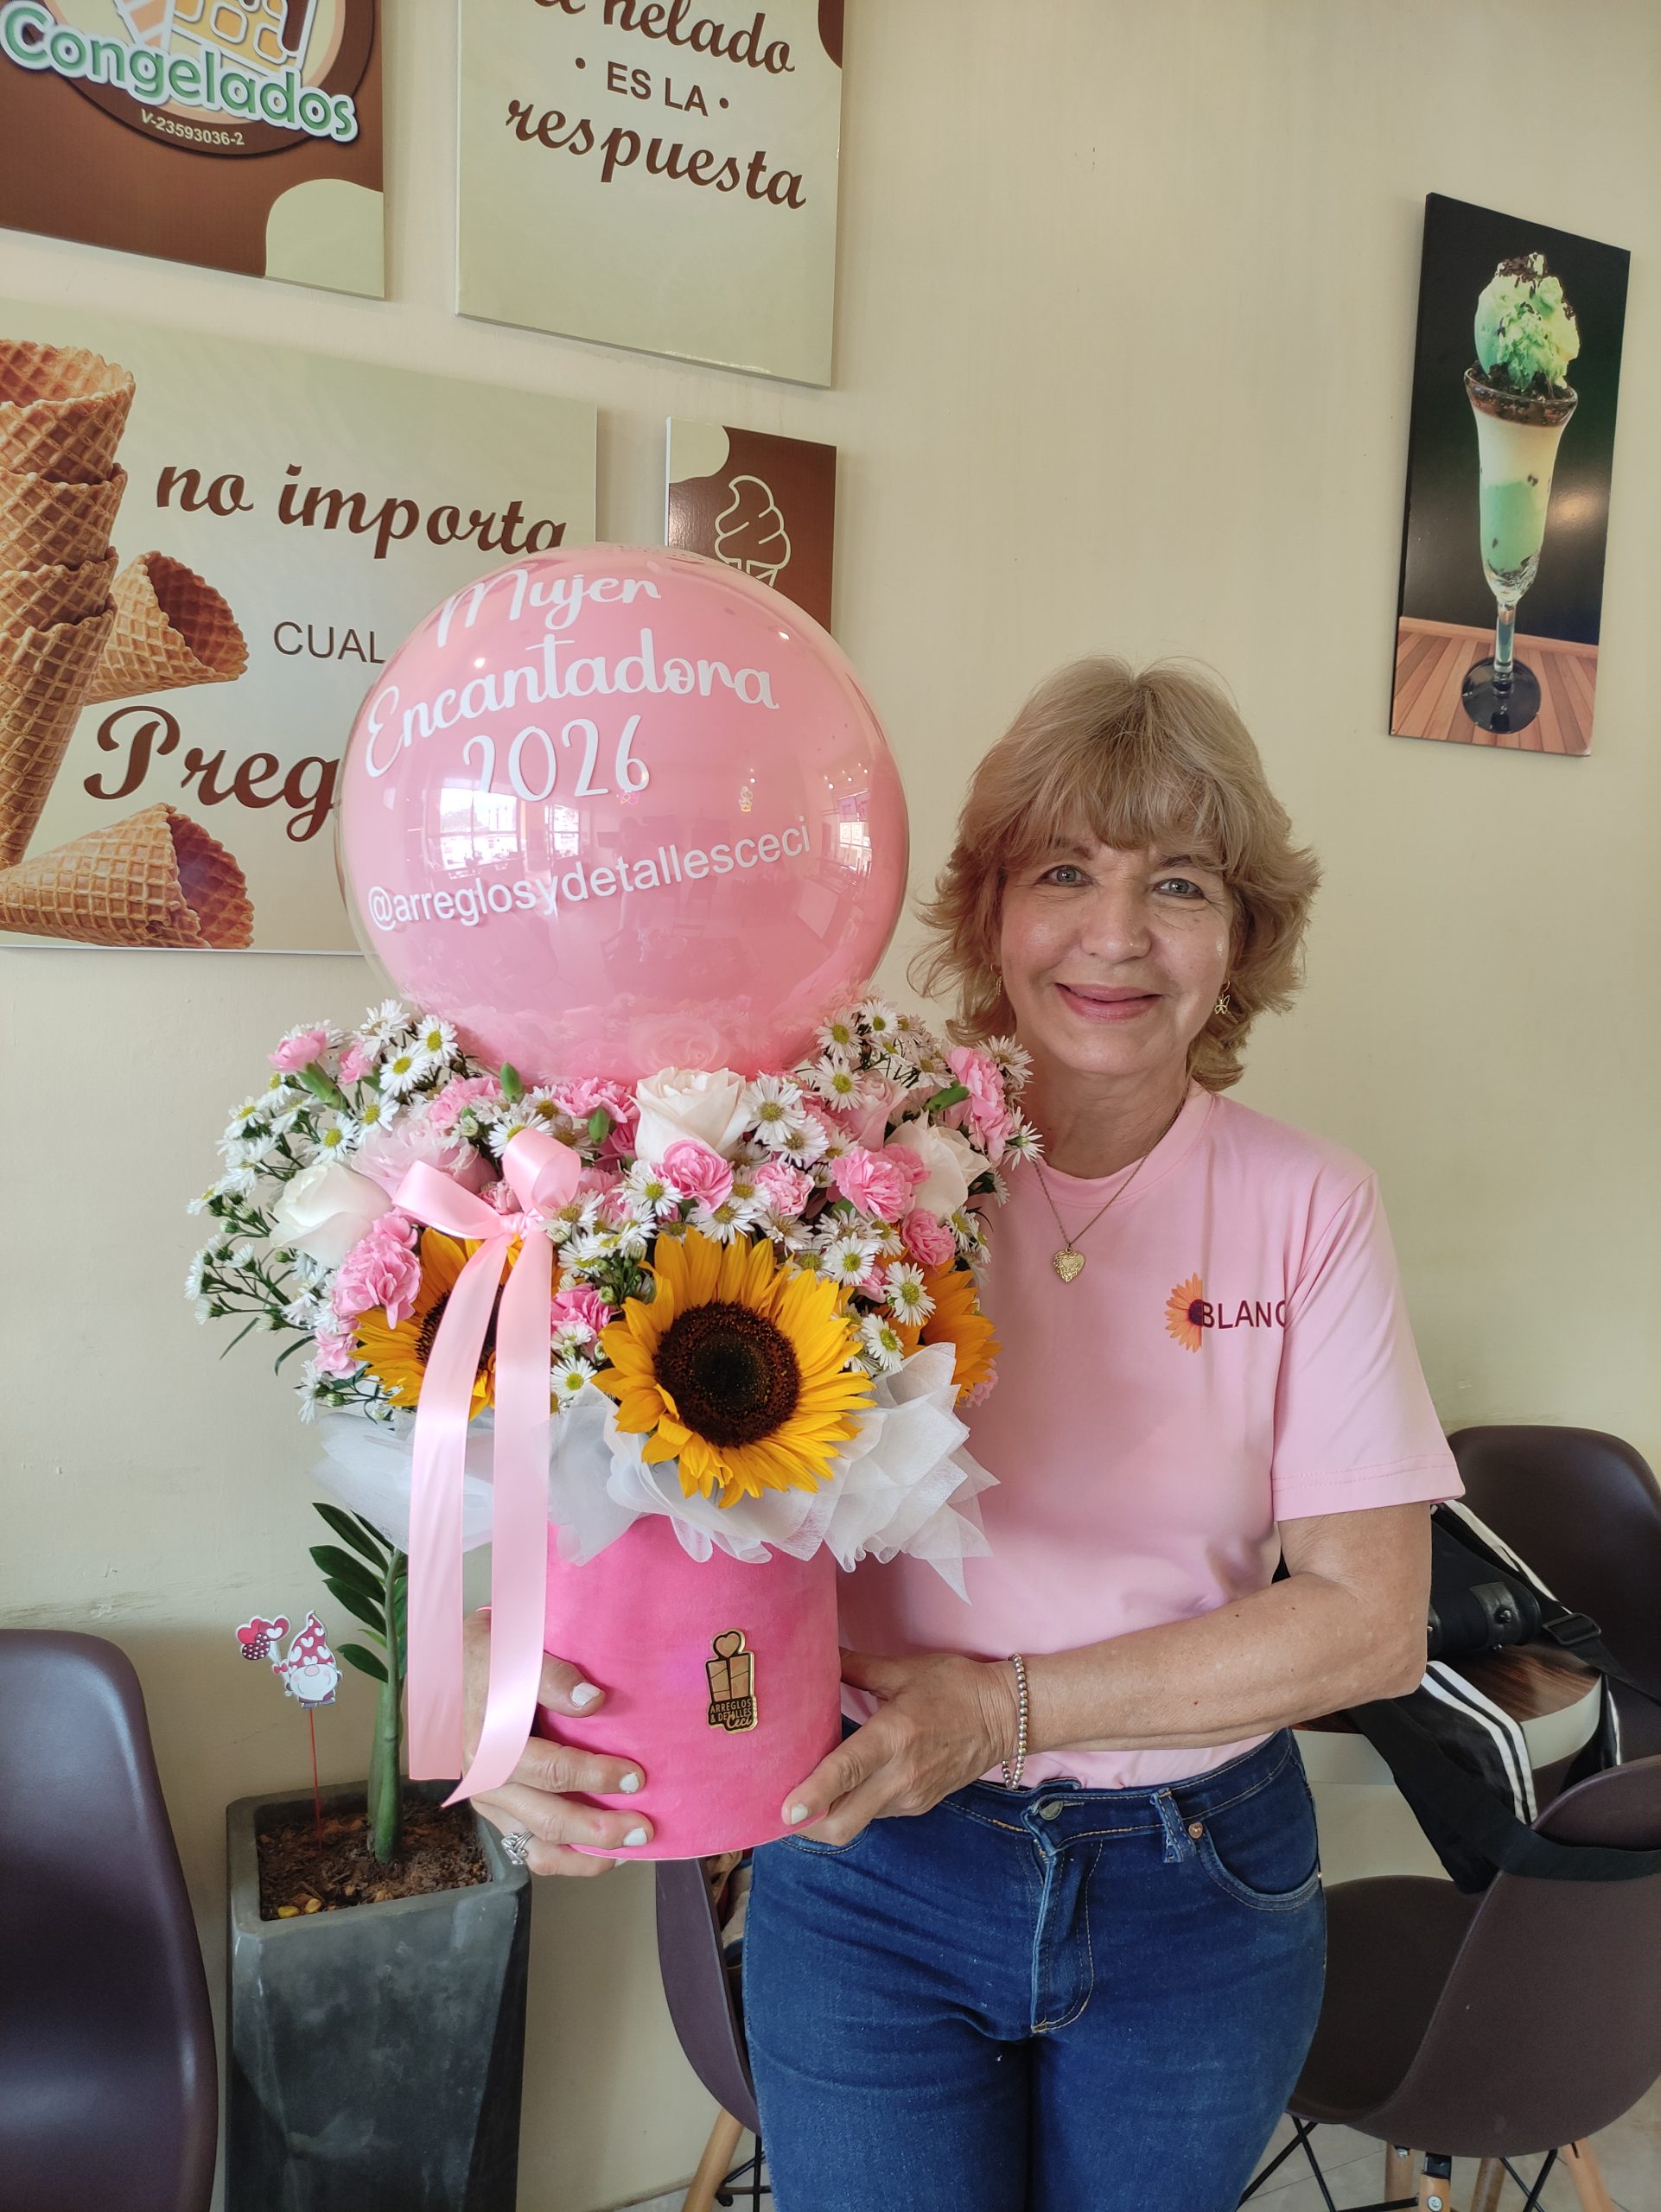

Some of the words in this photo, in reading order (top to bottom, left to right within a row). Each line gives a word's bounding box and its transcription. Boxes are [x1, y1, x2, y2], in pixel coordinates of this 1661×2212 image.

[0, 3, 359, 143] Congelados
[607, 60, 652, 100] ES
[665, 77, 709, 117] LA
[140, 108, 245, 146] V-23593036-2
[506, 99, 807, 210] respuesta
[156, 466, 254, 517] no
[277, 463, 567, 559] importa
[273, 620, 386, 664] CUAL
[435, 568, 662, 647] Mujer
[365, 627, 780, 778] Encantadora
[462, 715, 651, 803] 2026
[368, 815, 811, 931] @arreglosydetallesceci
[710, 1698, 752, 1714] ARREGLOS
